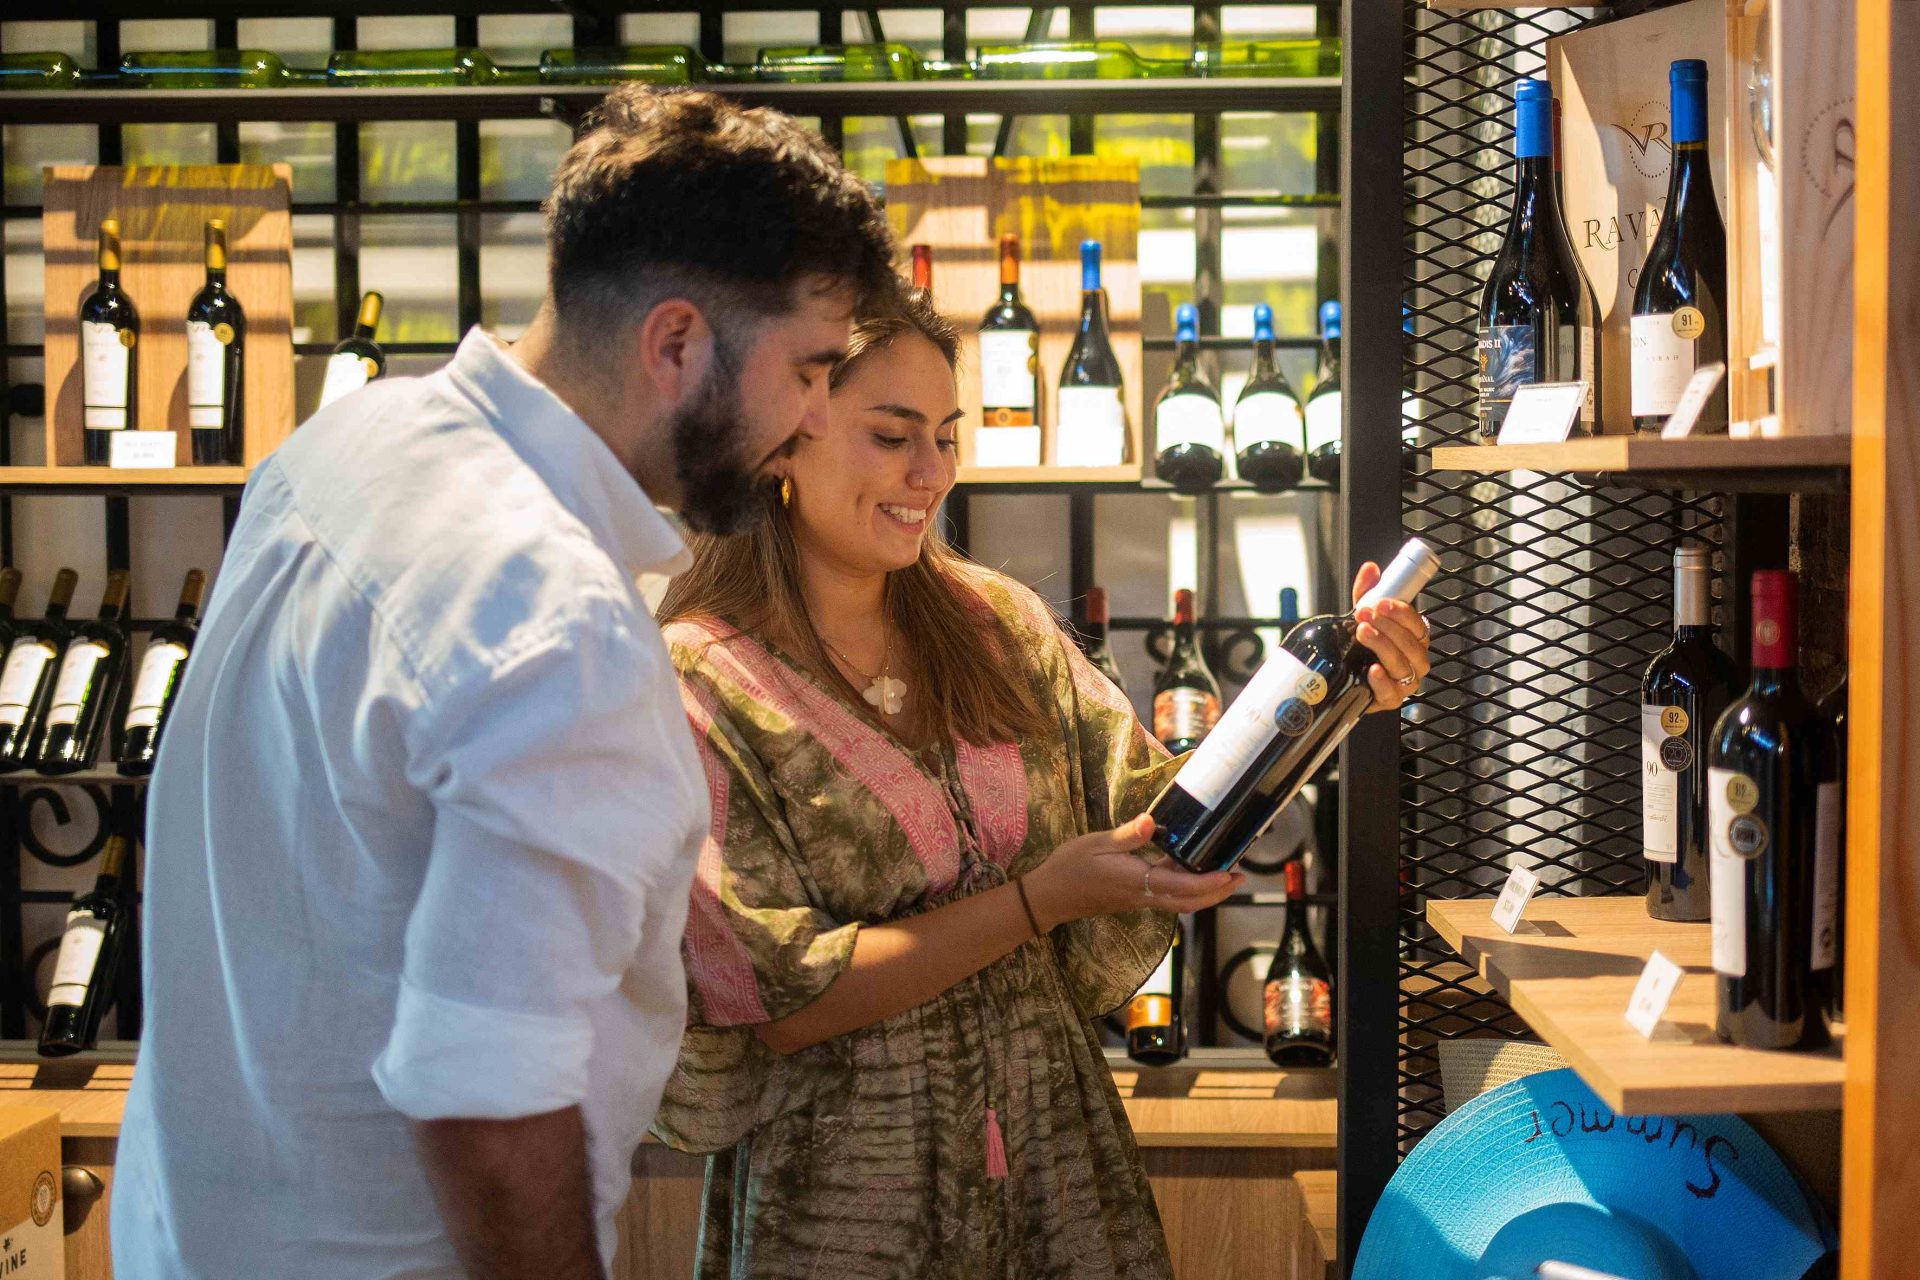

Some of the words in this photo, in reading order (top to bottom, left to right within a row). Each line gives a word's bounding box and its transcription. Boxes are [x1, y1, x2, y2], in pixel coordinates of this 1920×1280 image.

[1583, 208, 1663, 251] RAVA
[1681, 314, 1692, 327] 91
[1307, 679, 1321, 692] 92
[1668, 712, 1679, 723] 92
[1646, 761, 1658, 777] 90
